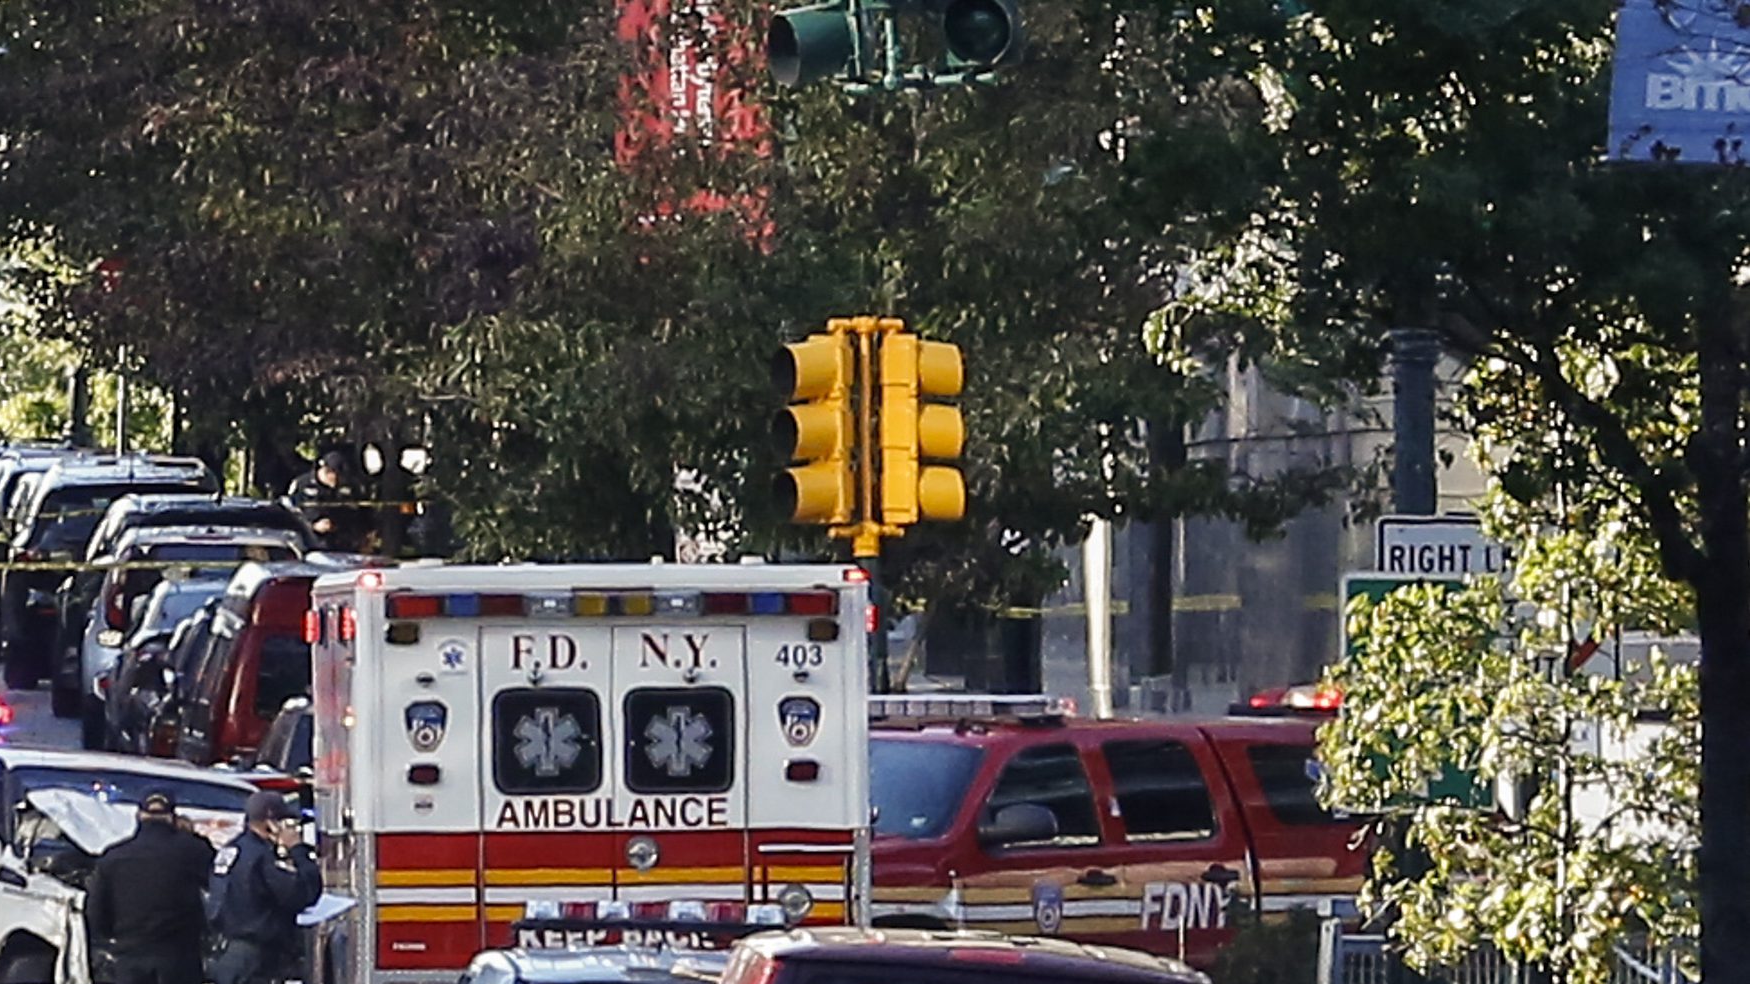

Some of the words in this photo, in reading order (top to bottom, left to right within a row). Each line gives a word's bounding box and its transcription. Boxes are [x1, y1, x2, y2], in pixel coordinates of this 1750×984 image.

[1389, 545, 1472, 573] RIGHT
[510, 634, 589, 671] F.D.
[639, 632, 718, 668] N.Y.
[775, 644, 823, 667] 403
[496, 797, 728, 829] AMBULANCE
[1141, 882, 1232, 931] FDNY
